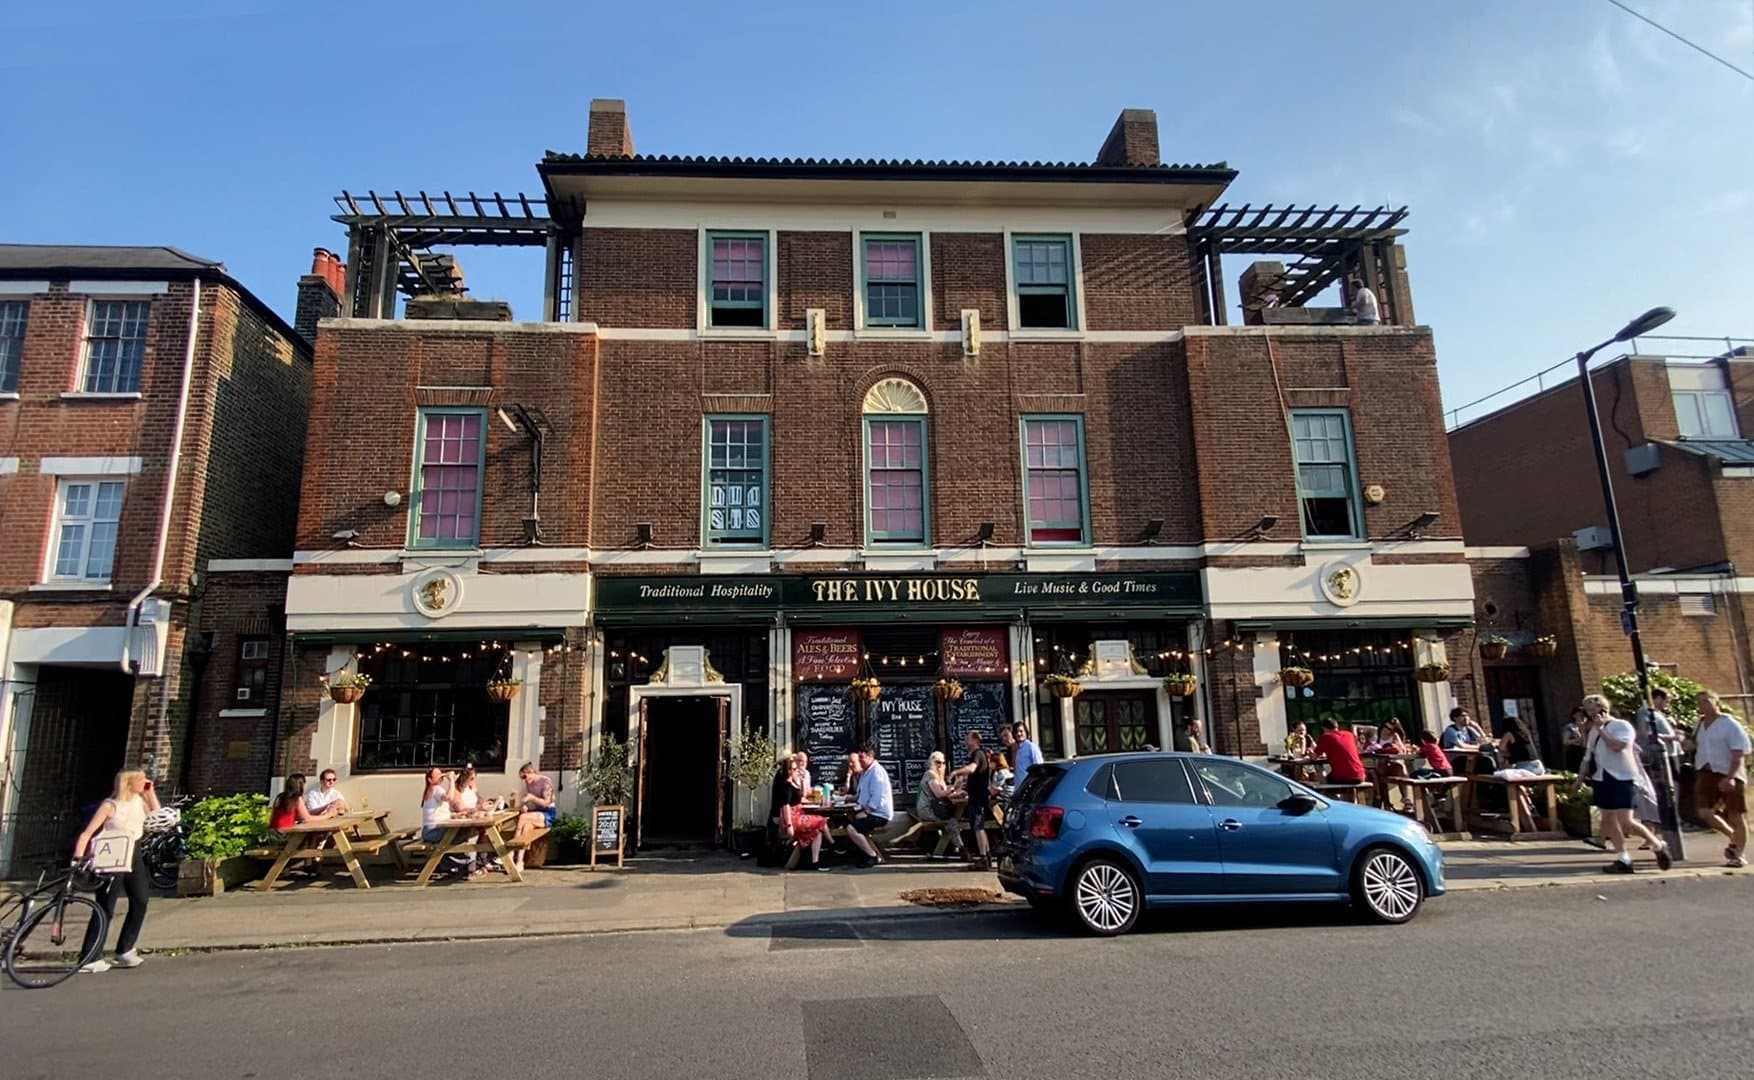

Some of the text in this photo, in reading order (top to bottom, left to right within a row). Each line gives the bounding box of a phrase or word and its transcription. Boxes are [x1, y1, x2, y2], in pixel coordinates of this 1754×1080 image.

[640, 584, 773, 599] Traditional Hospitality
[812, 579, 980, 601] THE IVY HOUSE
[1014, 581, 1157, 594] Live Music & Good Times
[797, 644, 822, 654] ALES
[830, 643, 857, 653] BEERS
[814, 664, 846, 672] FOOD
[881, 700, 923, 712] IVY HOUSE
[98, 842, 112, 855] A
